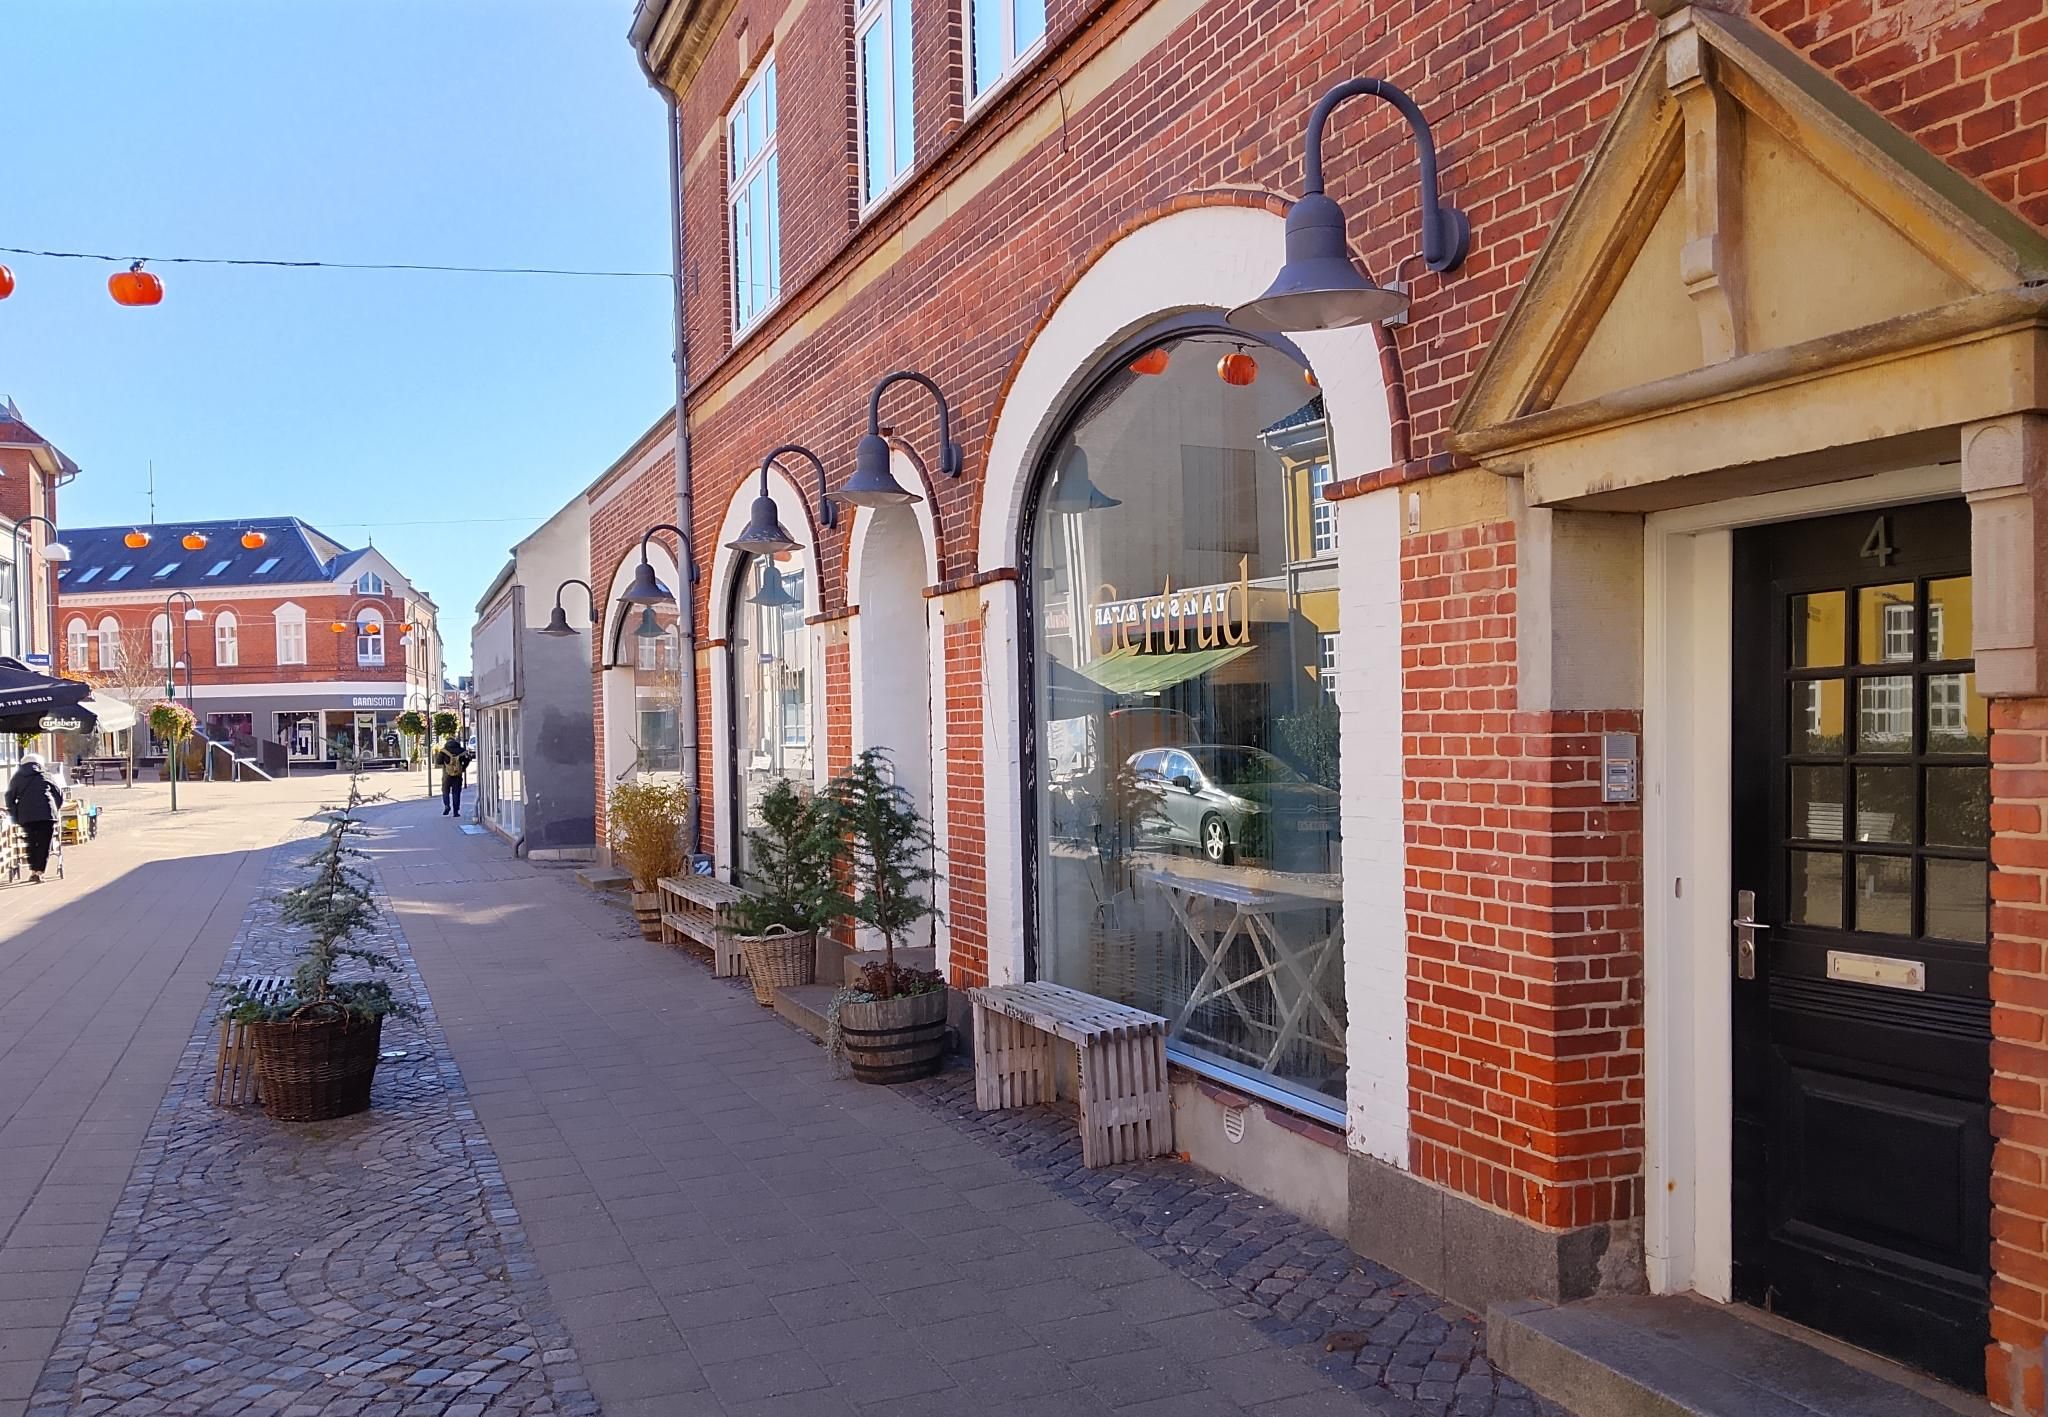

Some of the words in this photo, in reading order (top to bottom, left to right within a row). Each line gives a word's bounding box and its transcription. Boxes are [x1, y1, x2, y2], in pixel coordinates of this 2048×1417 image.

[1860, 515, 1893, 568] 4
[1090, 553, 1250, 657] Gertrud
[25, 696, 53, 704] WORLD
[39, 716, 81, 731] Carlsberg
